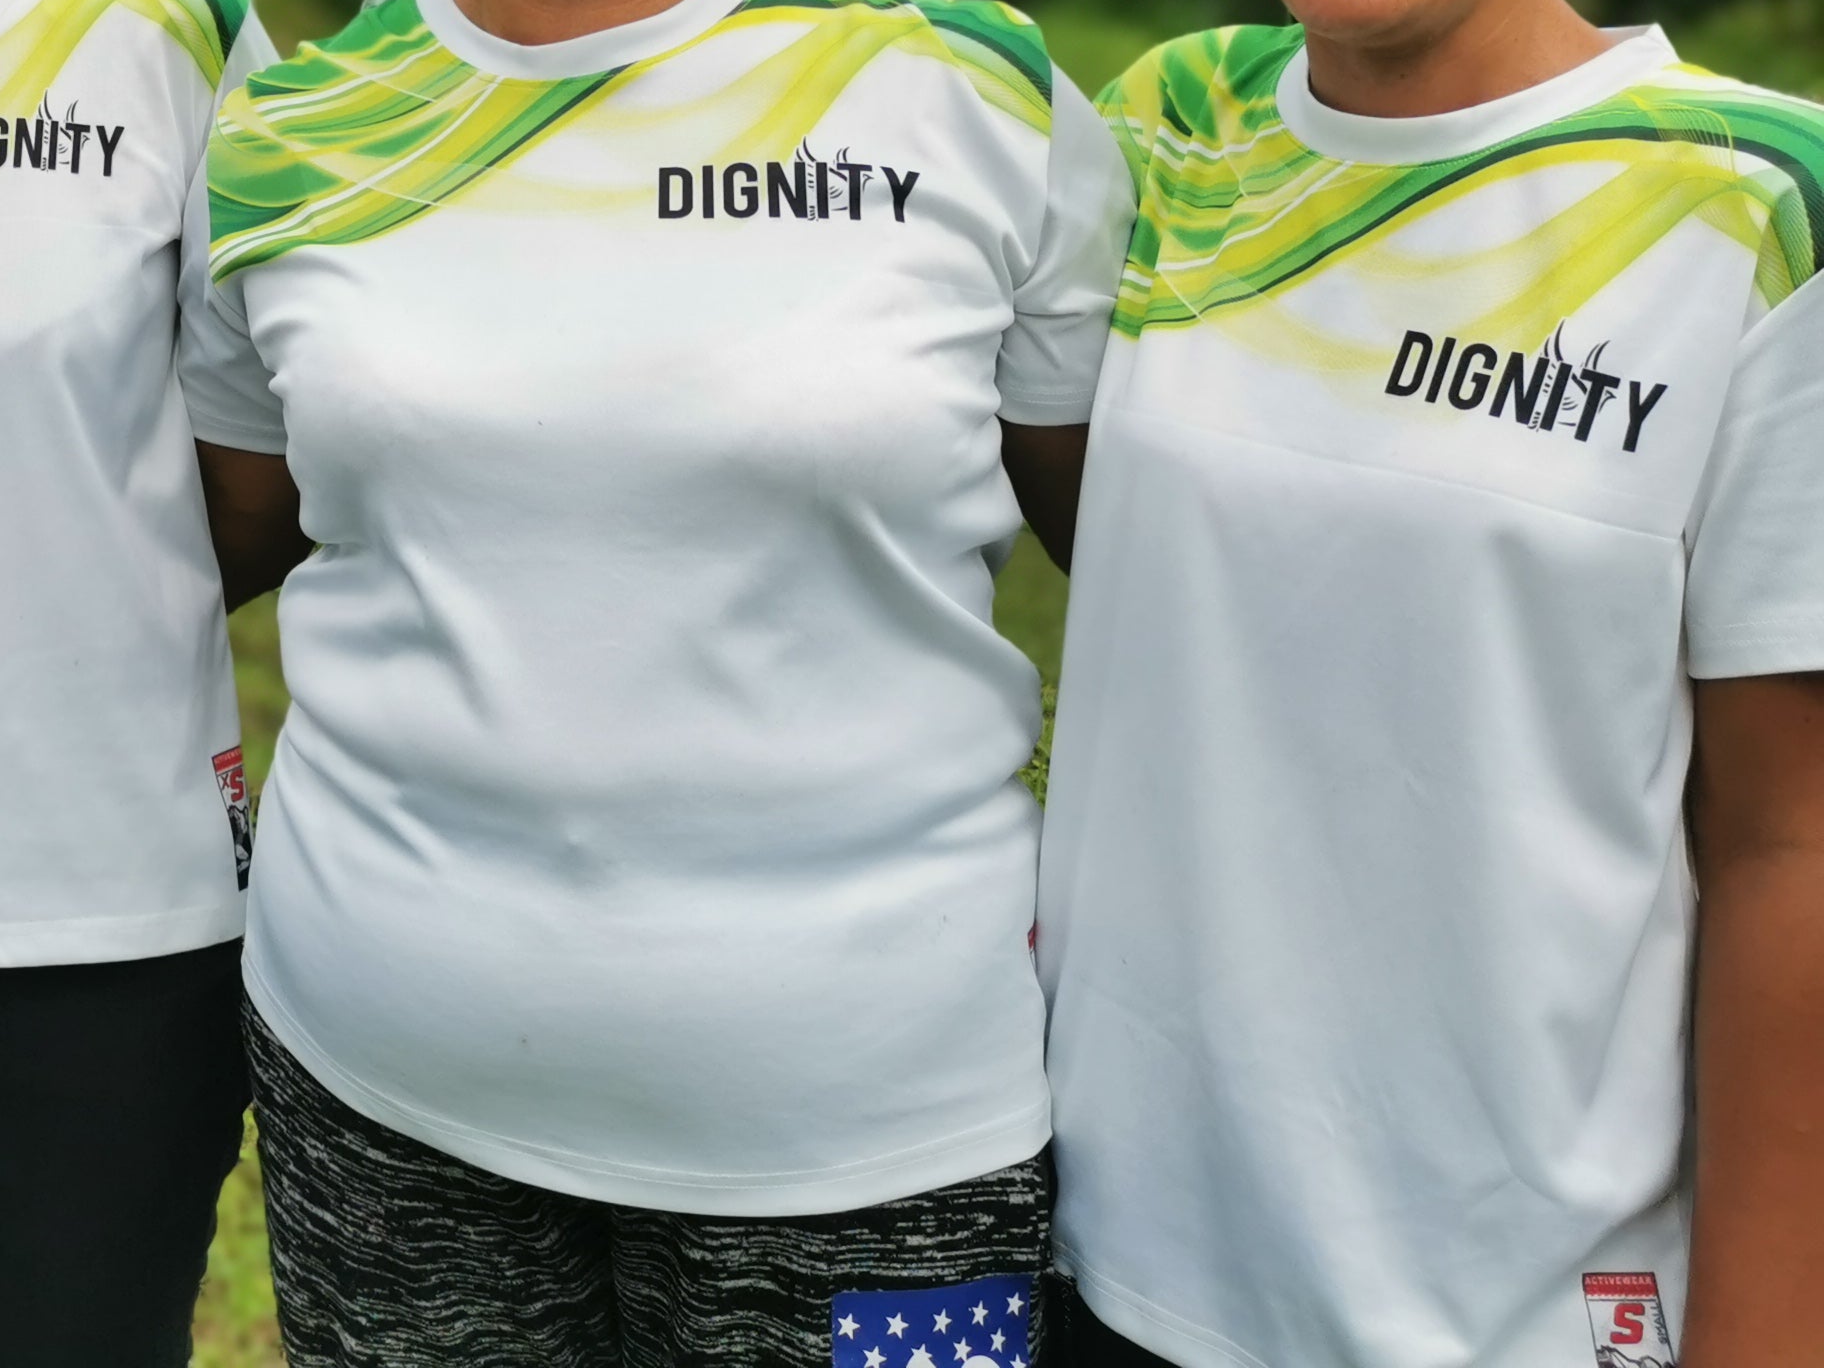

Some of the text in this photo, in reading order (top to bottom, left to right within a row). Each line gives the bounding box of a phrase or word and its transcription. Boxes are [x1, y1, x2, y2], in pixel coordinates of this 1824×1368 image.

[658, 162, 920, 223] DIGNITY
[1384, 330, 1668, 453] DIGNITY
[1584, 1275, 1652, 1286] ACTIVEWEAR
[1609, 1302, 1646, 1344] S
